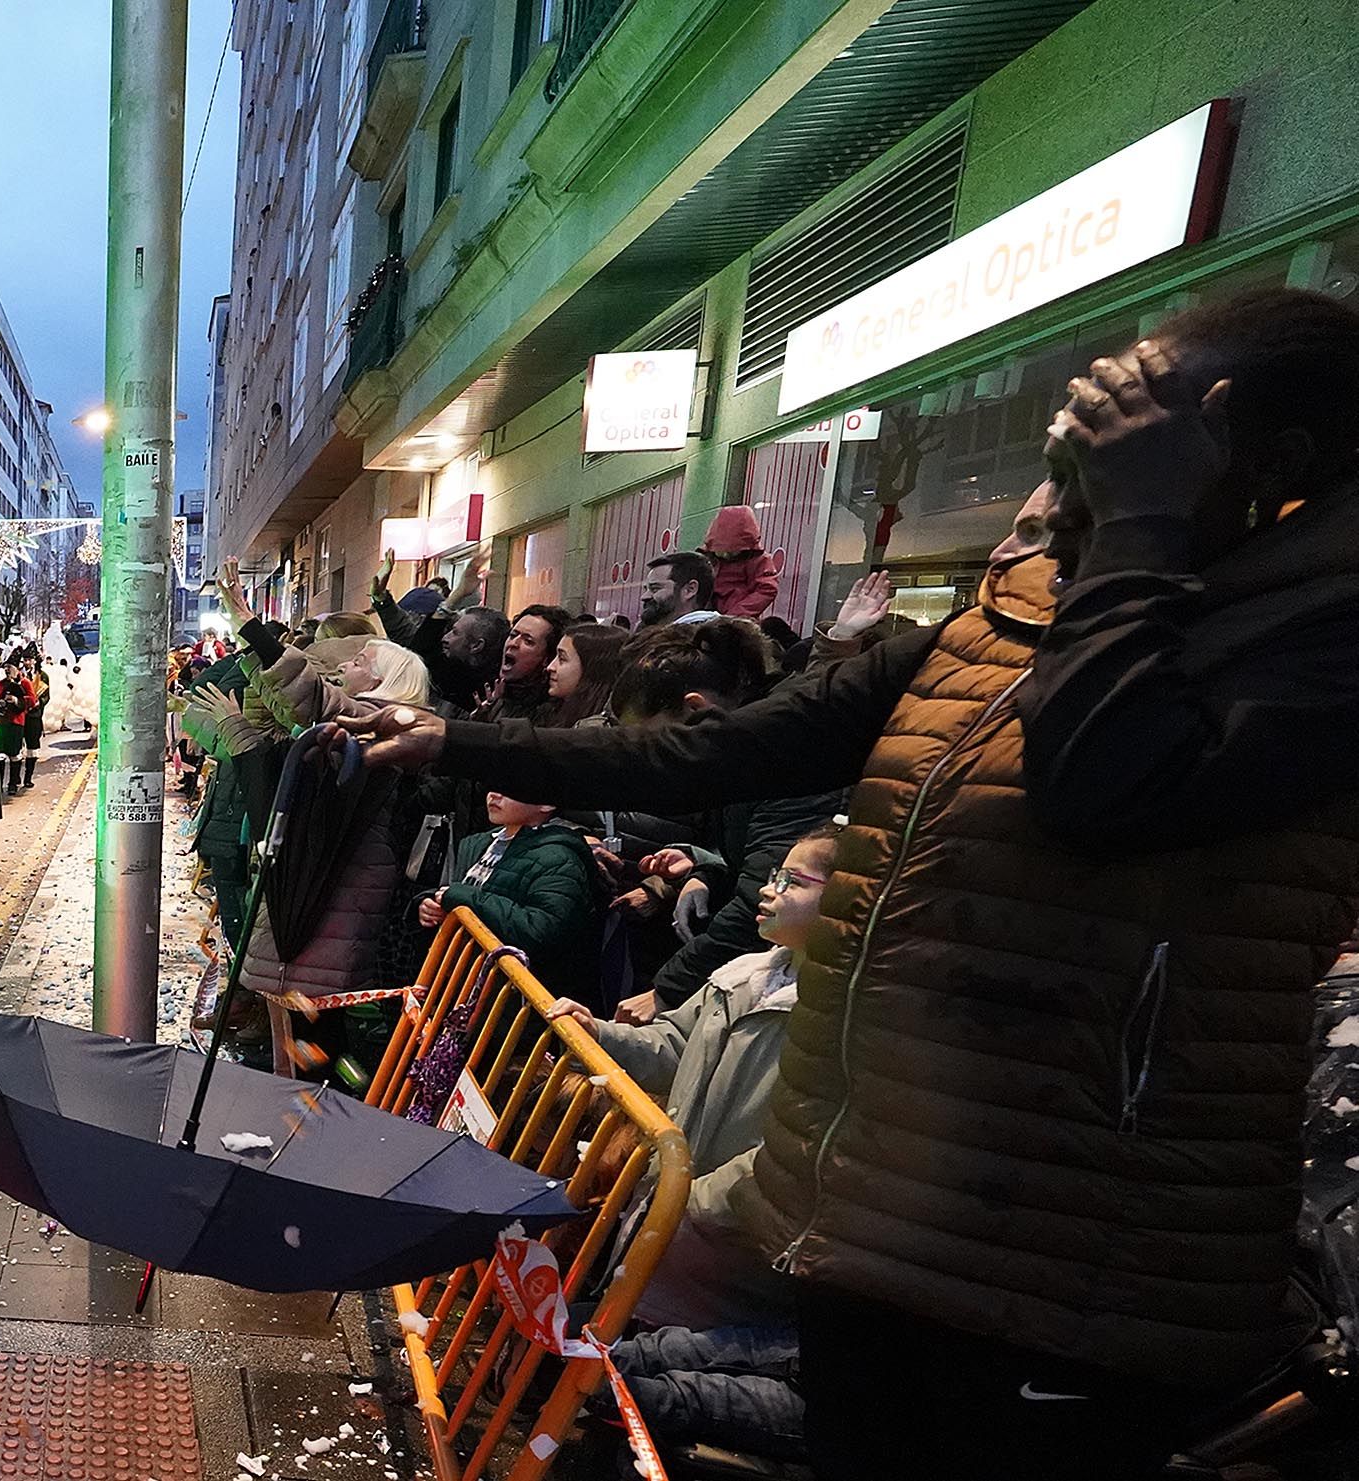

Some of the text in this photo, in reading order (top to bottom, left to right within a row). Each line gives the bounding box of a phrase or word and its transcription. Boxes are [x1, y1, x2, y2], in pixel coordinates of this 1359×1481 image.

[852, 198, 1122, 358] General Optica
[600, 403, 679, 423] Gneral
[605, 423, 669, 444] Optica
[125, 453, 158, 467] BAILE
[108, 812, 125, 821] 643
[128, 812, 146, 821] 588
